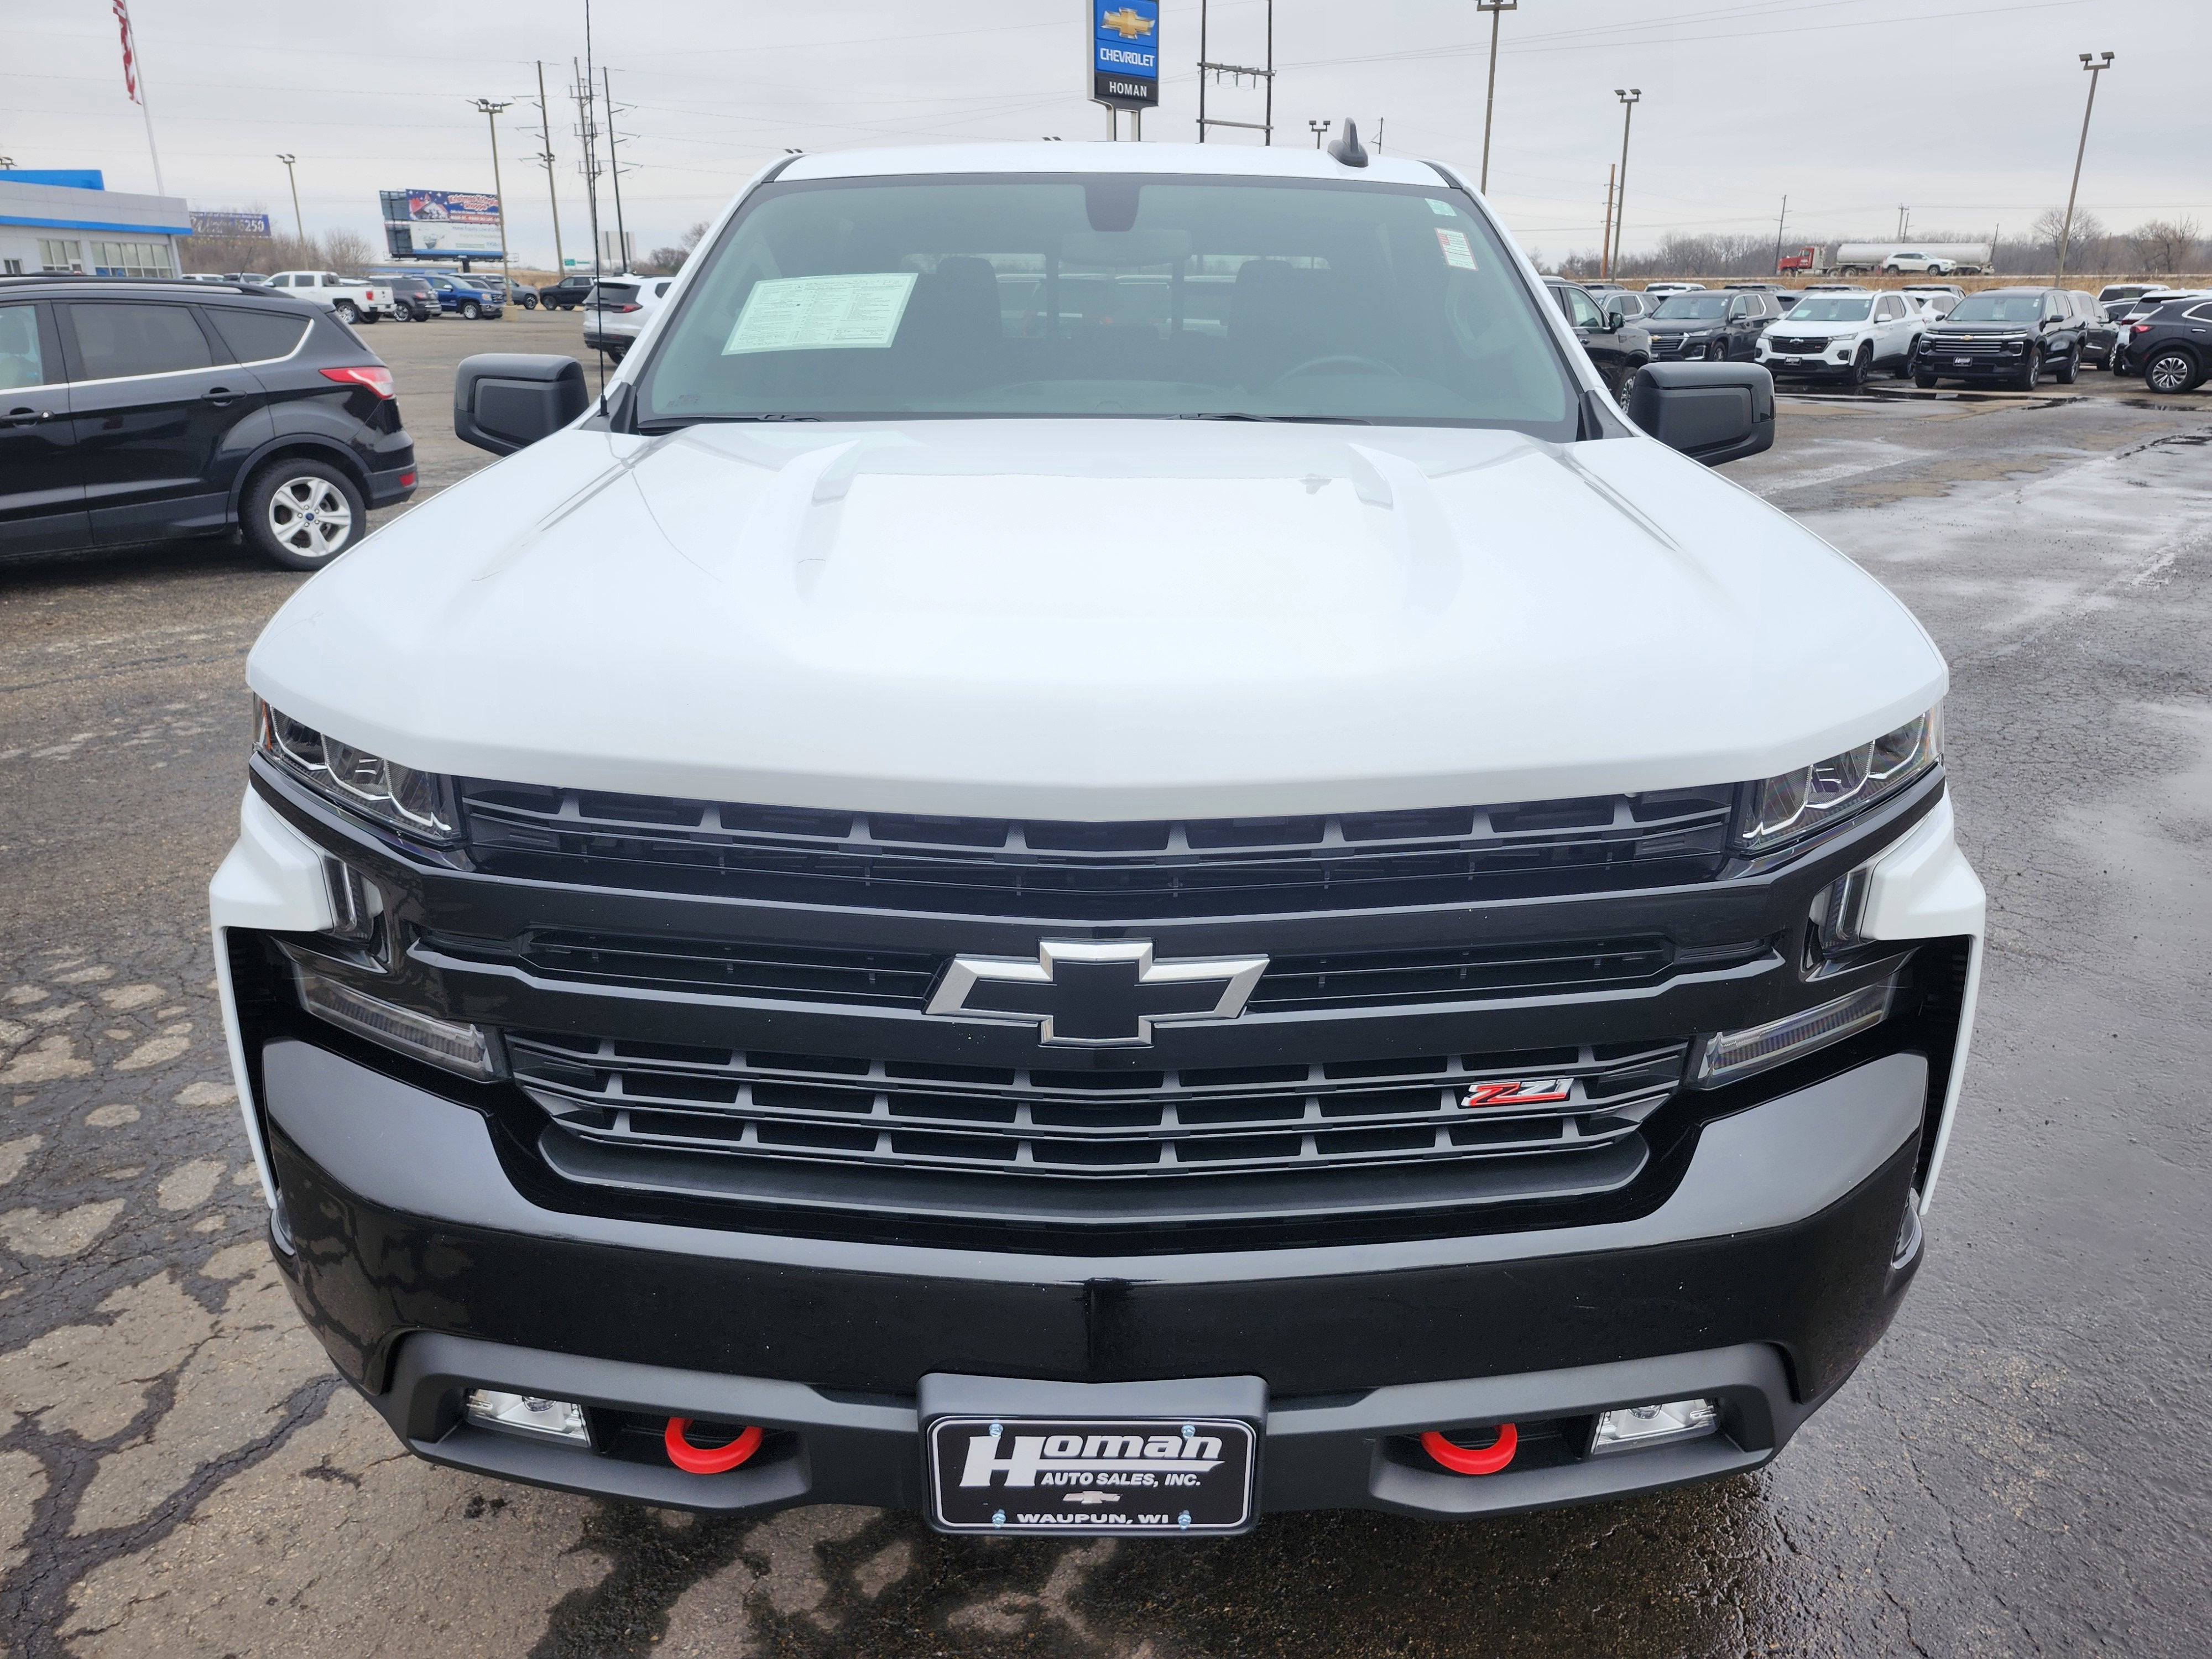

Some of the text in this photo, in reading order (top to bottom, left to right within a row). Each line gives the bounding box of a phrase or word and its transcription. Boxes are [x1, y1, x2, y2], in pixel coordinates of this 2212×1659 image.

[1100, 48, 1155, 67] CHEVROLET
[1109, 81, 1147, 97] HOMAN
[1461, 1078, 1574, 1107] Z71
[959, 1434, 1225, 1486] Homan
[1041, 1472, 1201, 1487] AUTO SALES, INC.
[1017, 1514, 1168, 1525] WAUPUN, WI
